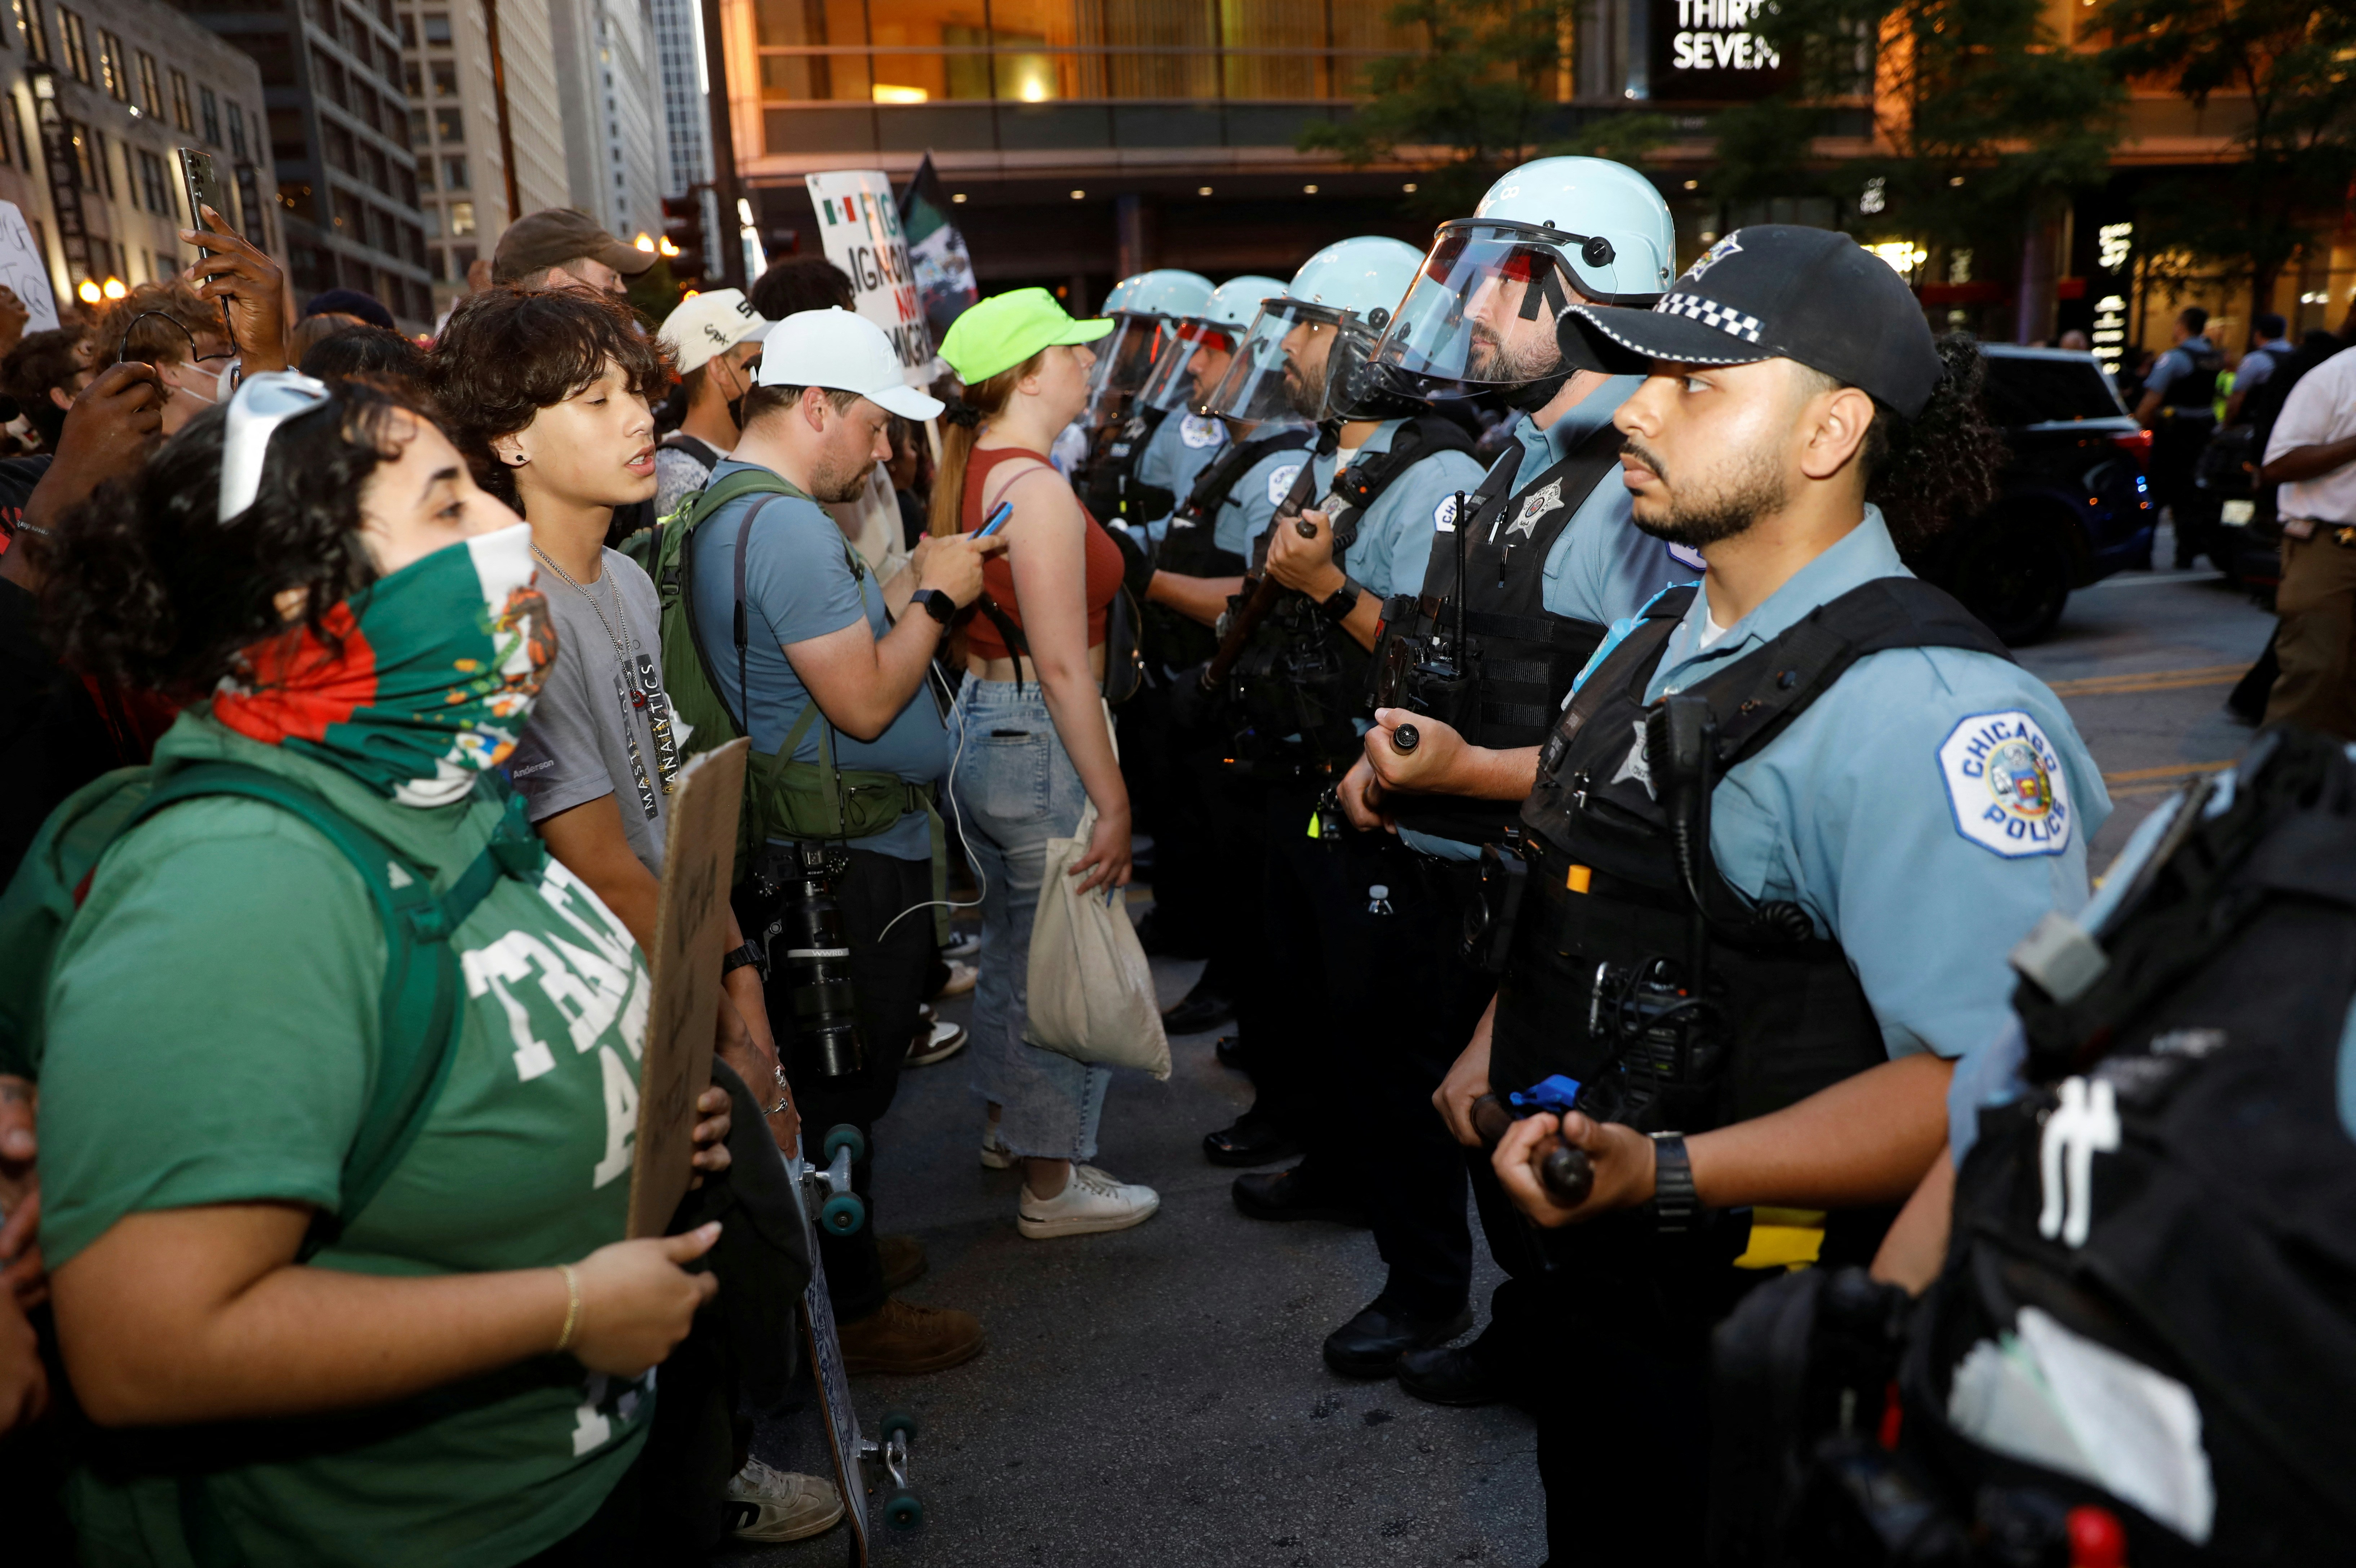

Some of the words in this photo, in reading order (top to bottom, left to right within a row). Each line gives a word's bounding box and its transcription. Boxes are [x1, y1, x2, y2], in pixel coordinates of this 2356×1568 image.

[1676, 0, 1782, 28] THIRT
[1673, 31, 1781, 70] SEVEN
[1540, 491, 1553, 512] POLICE
[641, 664, 678, 783] ANALYTICS
[514, 760, 554, 779] Anderson
[1962, 721, 2057, 779] CHICAGO
[1983, 797, 2065, 842] POLICE
